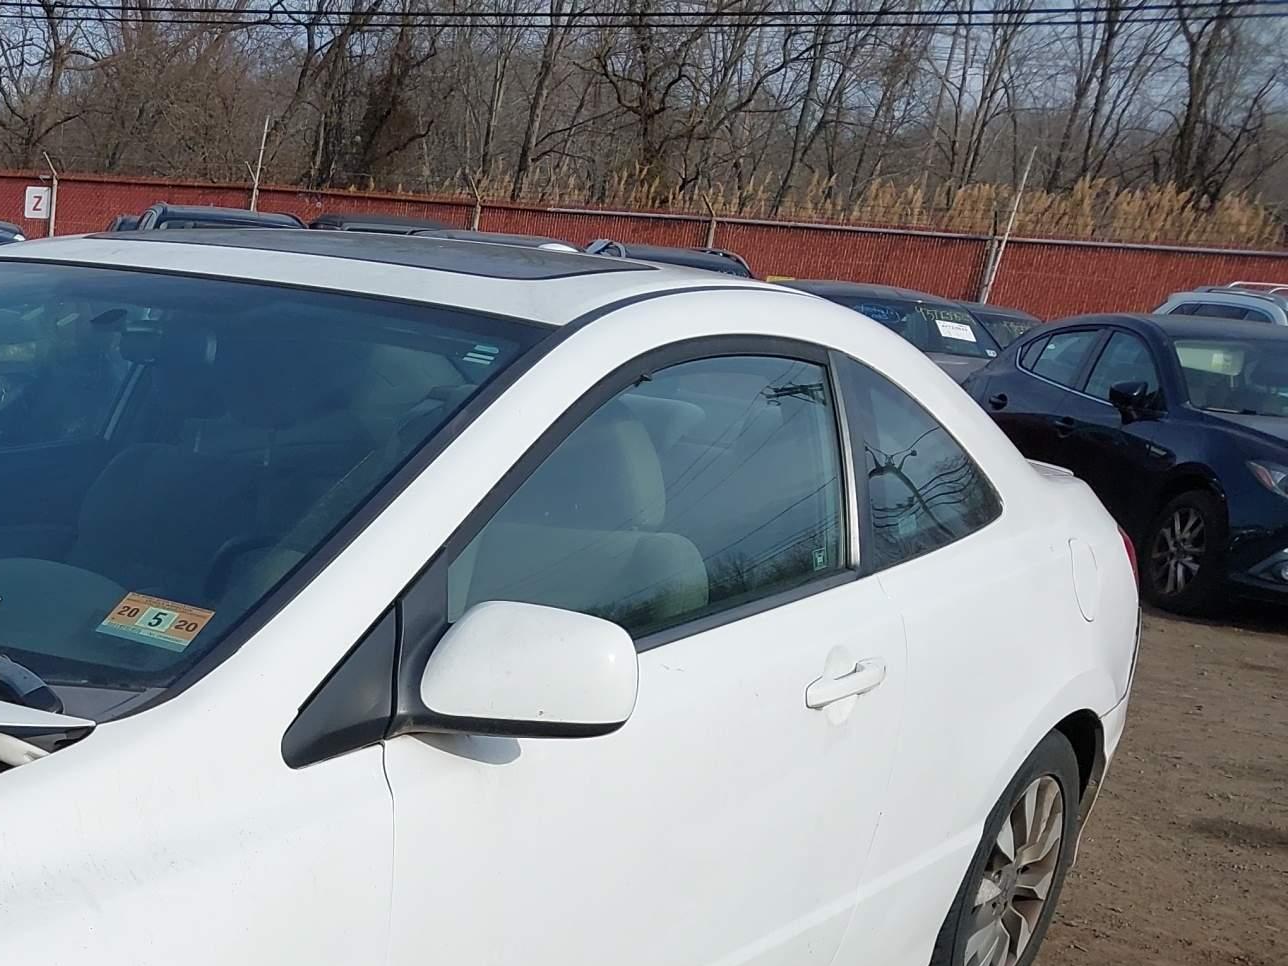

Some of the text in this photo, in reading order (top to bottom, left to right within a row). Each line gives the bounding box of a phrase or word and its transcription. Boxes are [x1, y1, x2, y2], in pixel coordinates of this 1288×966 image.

[32, 195, 43, 212] Z
[118, 605, 140, 618] 20
[148, 611, 168, 628] 5
[174, 619, 198, 633] 20
